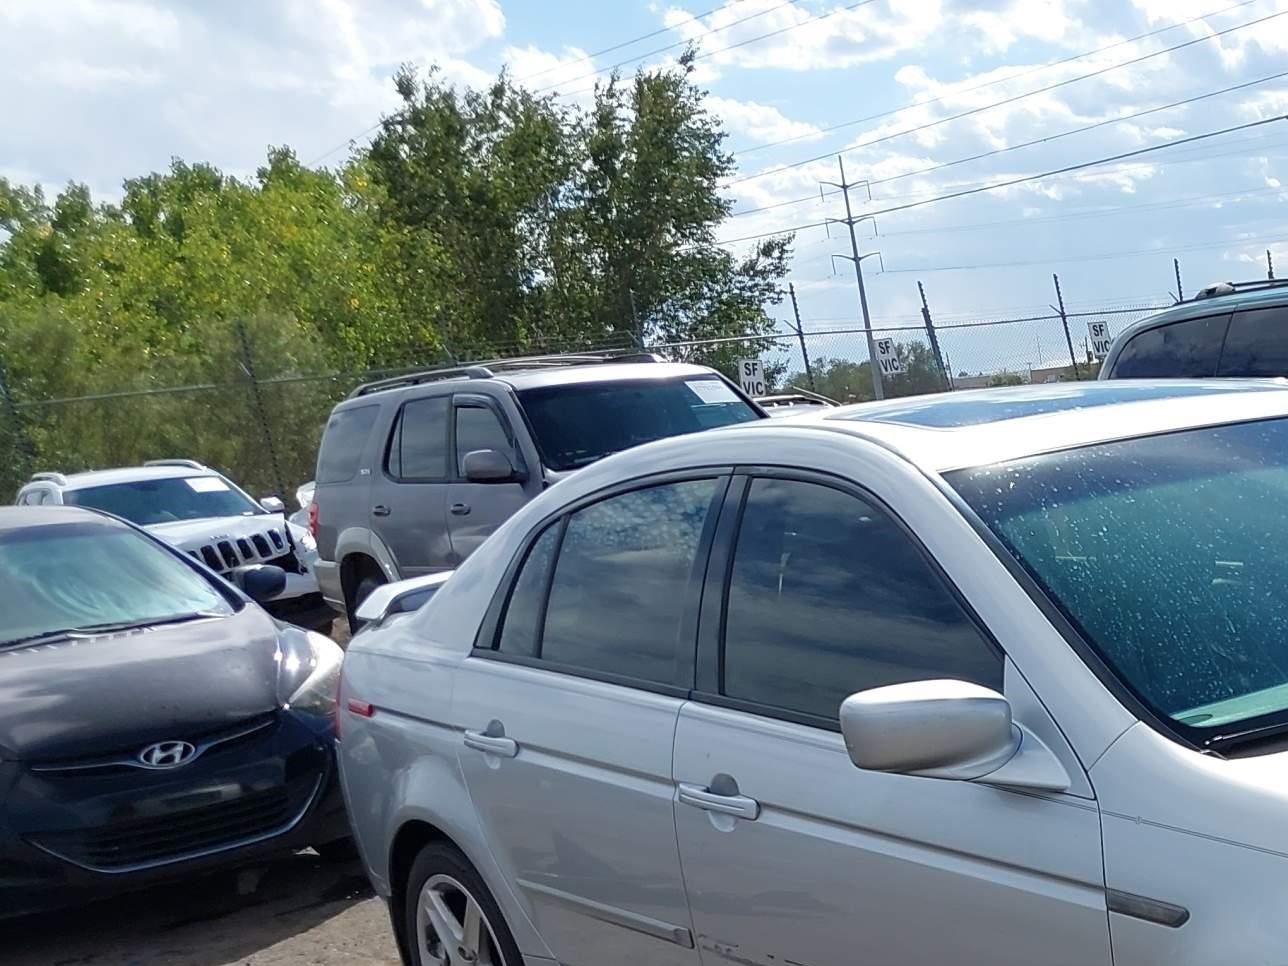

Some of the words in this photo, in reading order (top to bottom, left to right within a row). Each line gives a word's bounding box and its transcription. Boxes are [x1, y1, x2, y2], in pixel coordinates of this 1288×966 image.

[1092, 324, 1105, 337] SF
[878, 340, 891, 355] SF
[1093, 340, 1111, 353] VIC
[743, 362, 758, 377] SF
[880, 358, 899, 373] VIC
[743, 381, 764, 396] VIC
